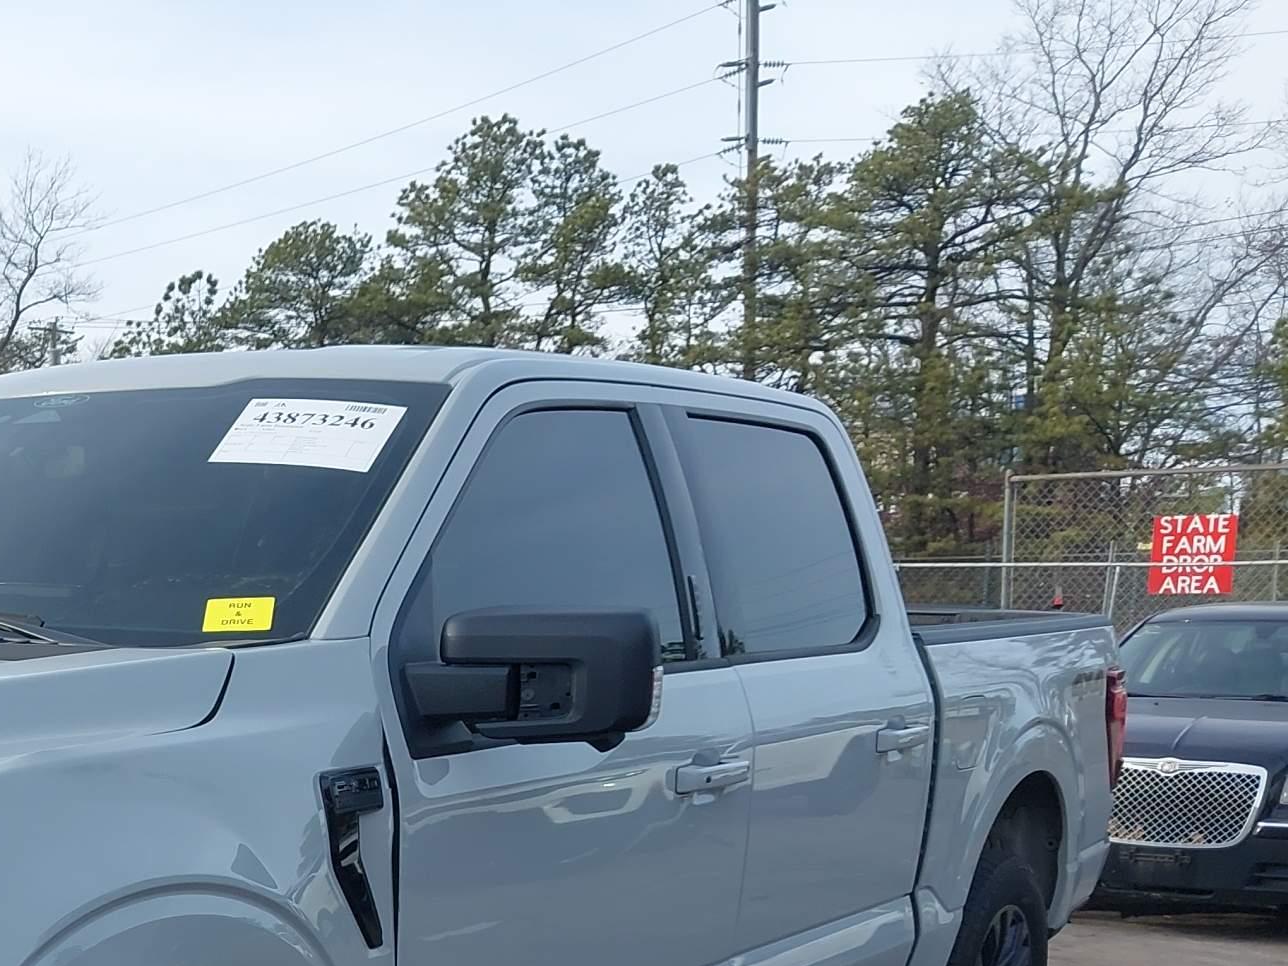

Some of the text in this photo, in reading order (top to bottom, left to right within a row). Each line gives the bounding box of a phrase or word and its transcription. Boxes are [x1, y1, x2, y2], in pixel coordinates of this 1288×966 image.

[253, 411, 377, 430] 43873246
[1159, 514, 1231, 534] STATE
[1162, 535, 1227, 554] FARM
[1161, 554, 1223, 574] DROP
[1158, 576, 1220, 594] AREA
[221, 618, 254, 626] DRIVE
